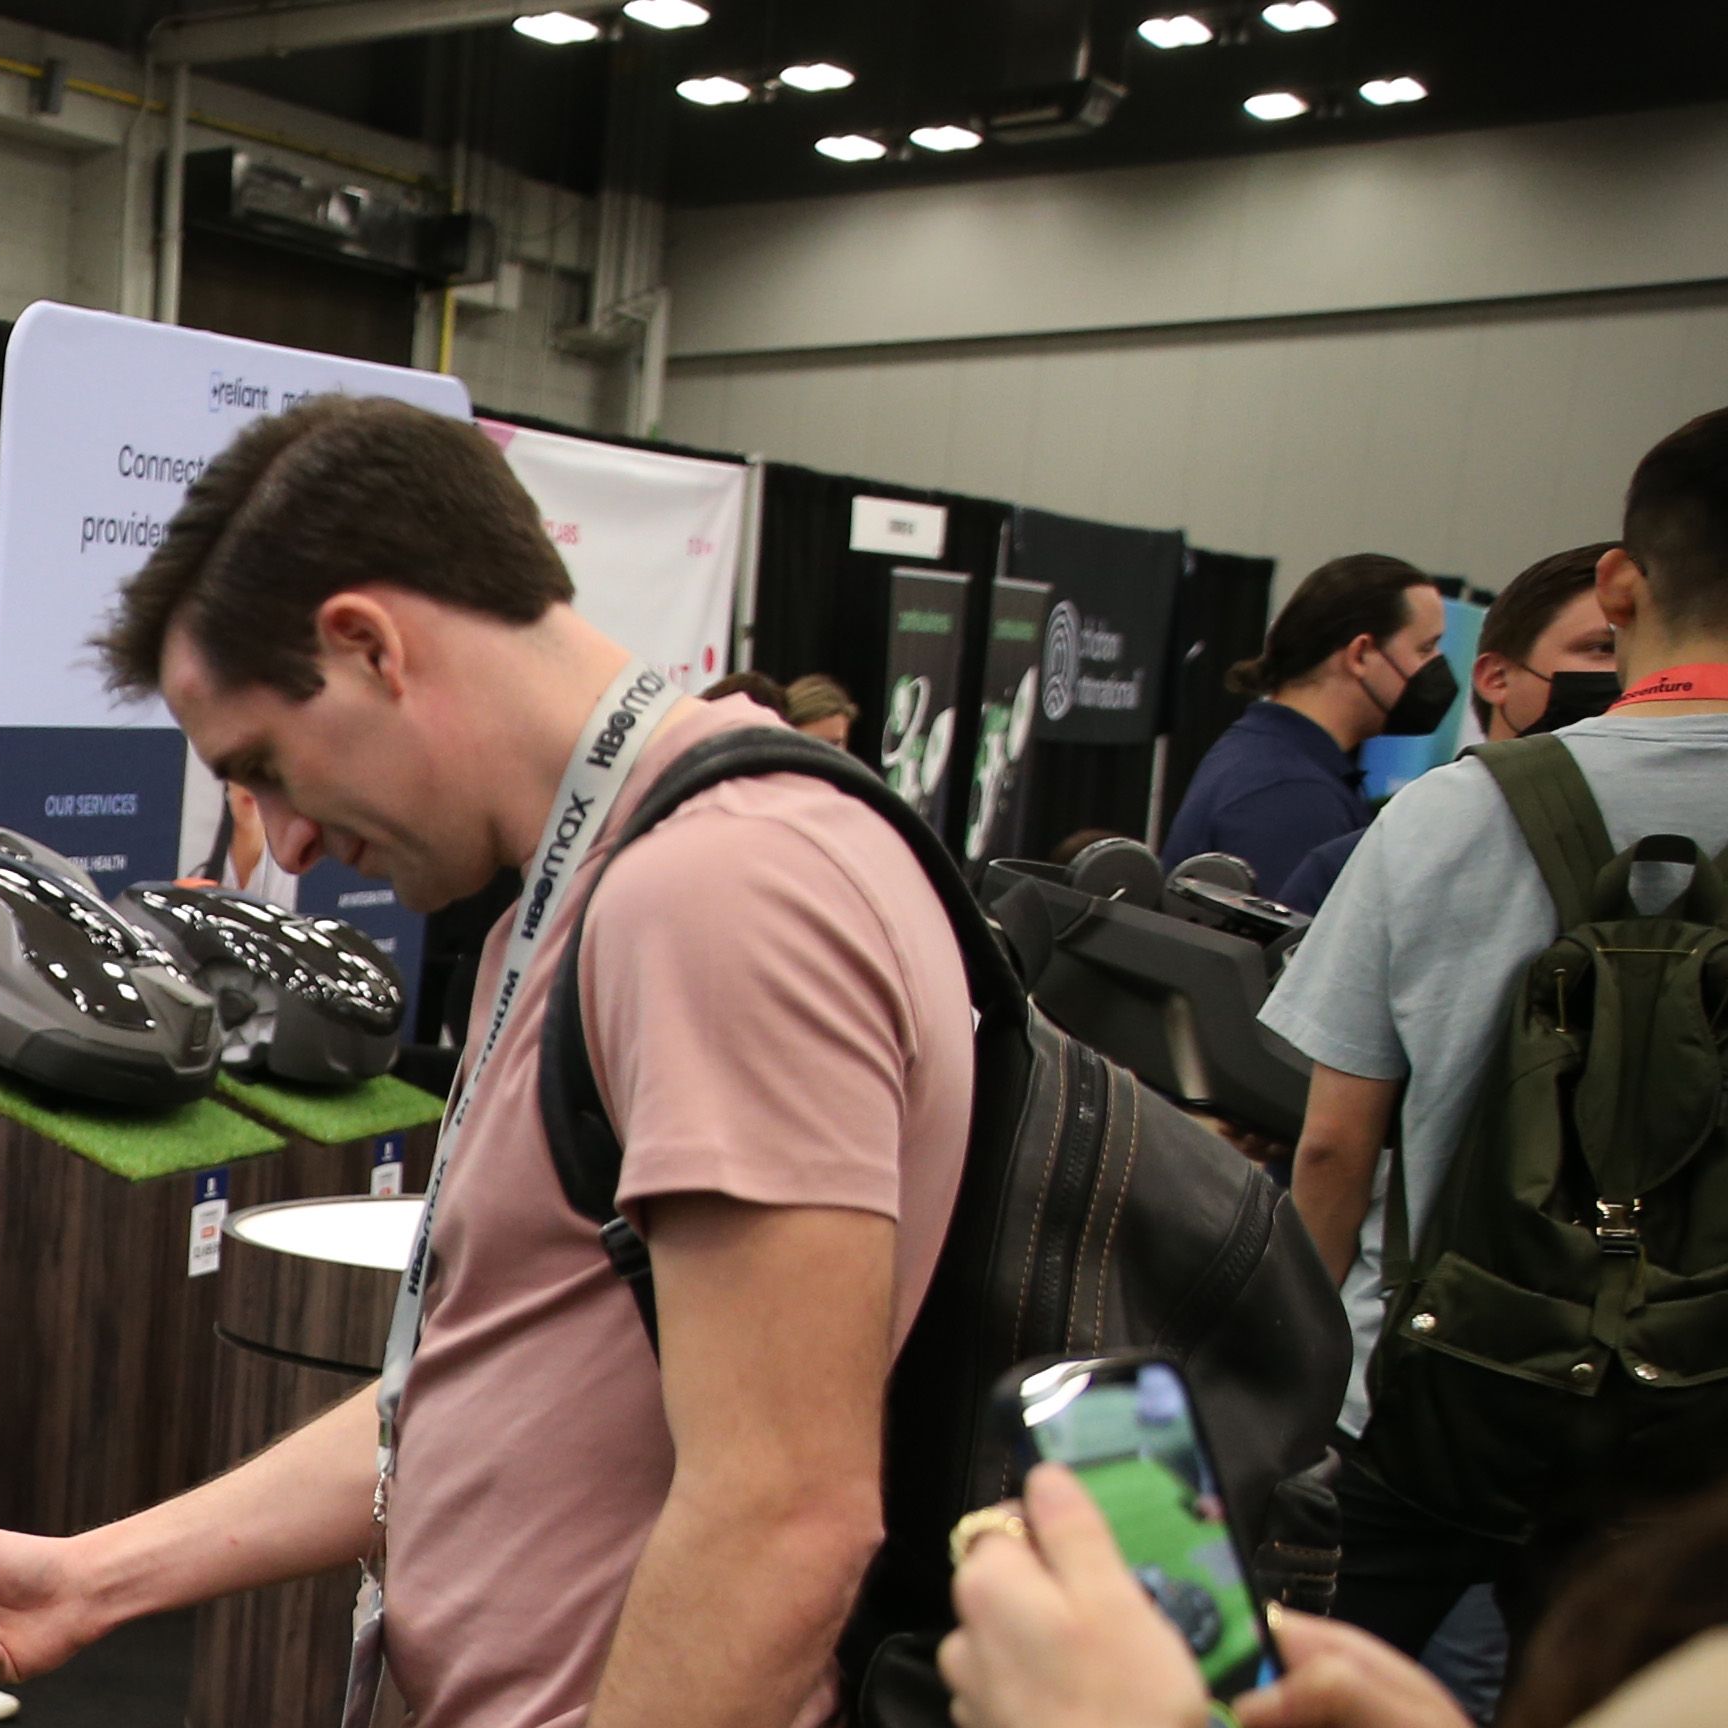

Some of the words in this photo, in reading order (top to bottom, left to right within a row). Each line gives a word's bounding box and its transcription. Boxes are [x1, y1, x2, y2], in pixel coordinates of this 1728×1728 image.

[217, 378, 269, 411] reliant
[45, 795, 74, 817] OUR
[76, 793, 139, 816] SERVICES
